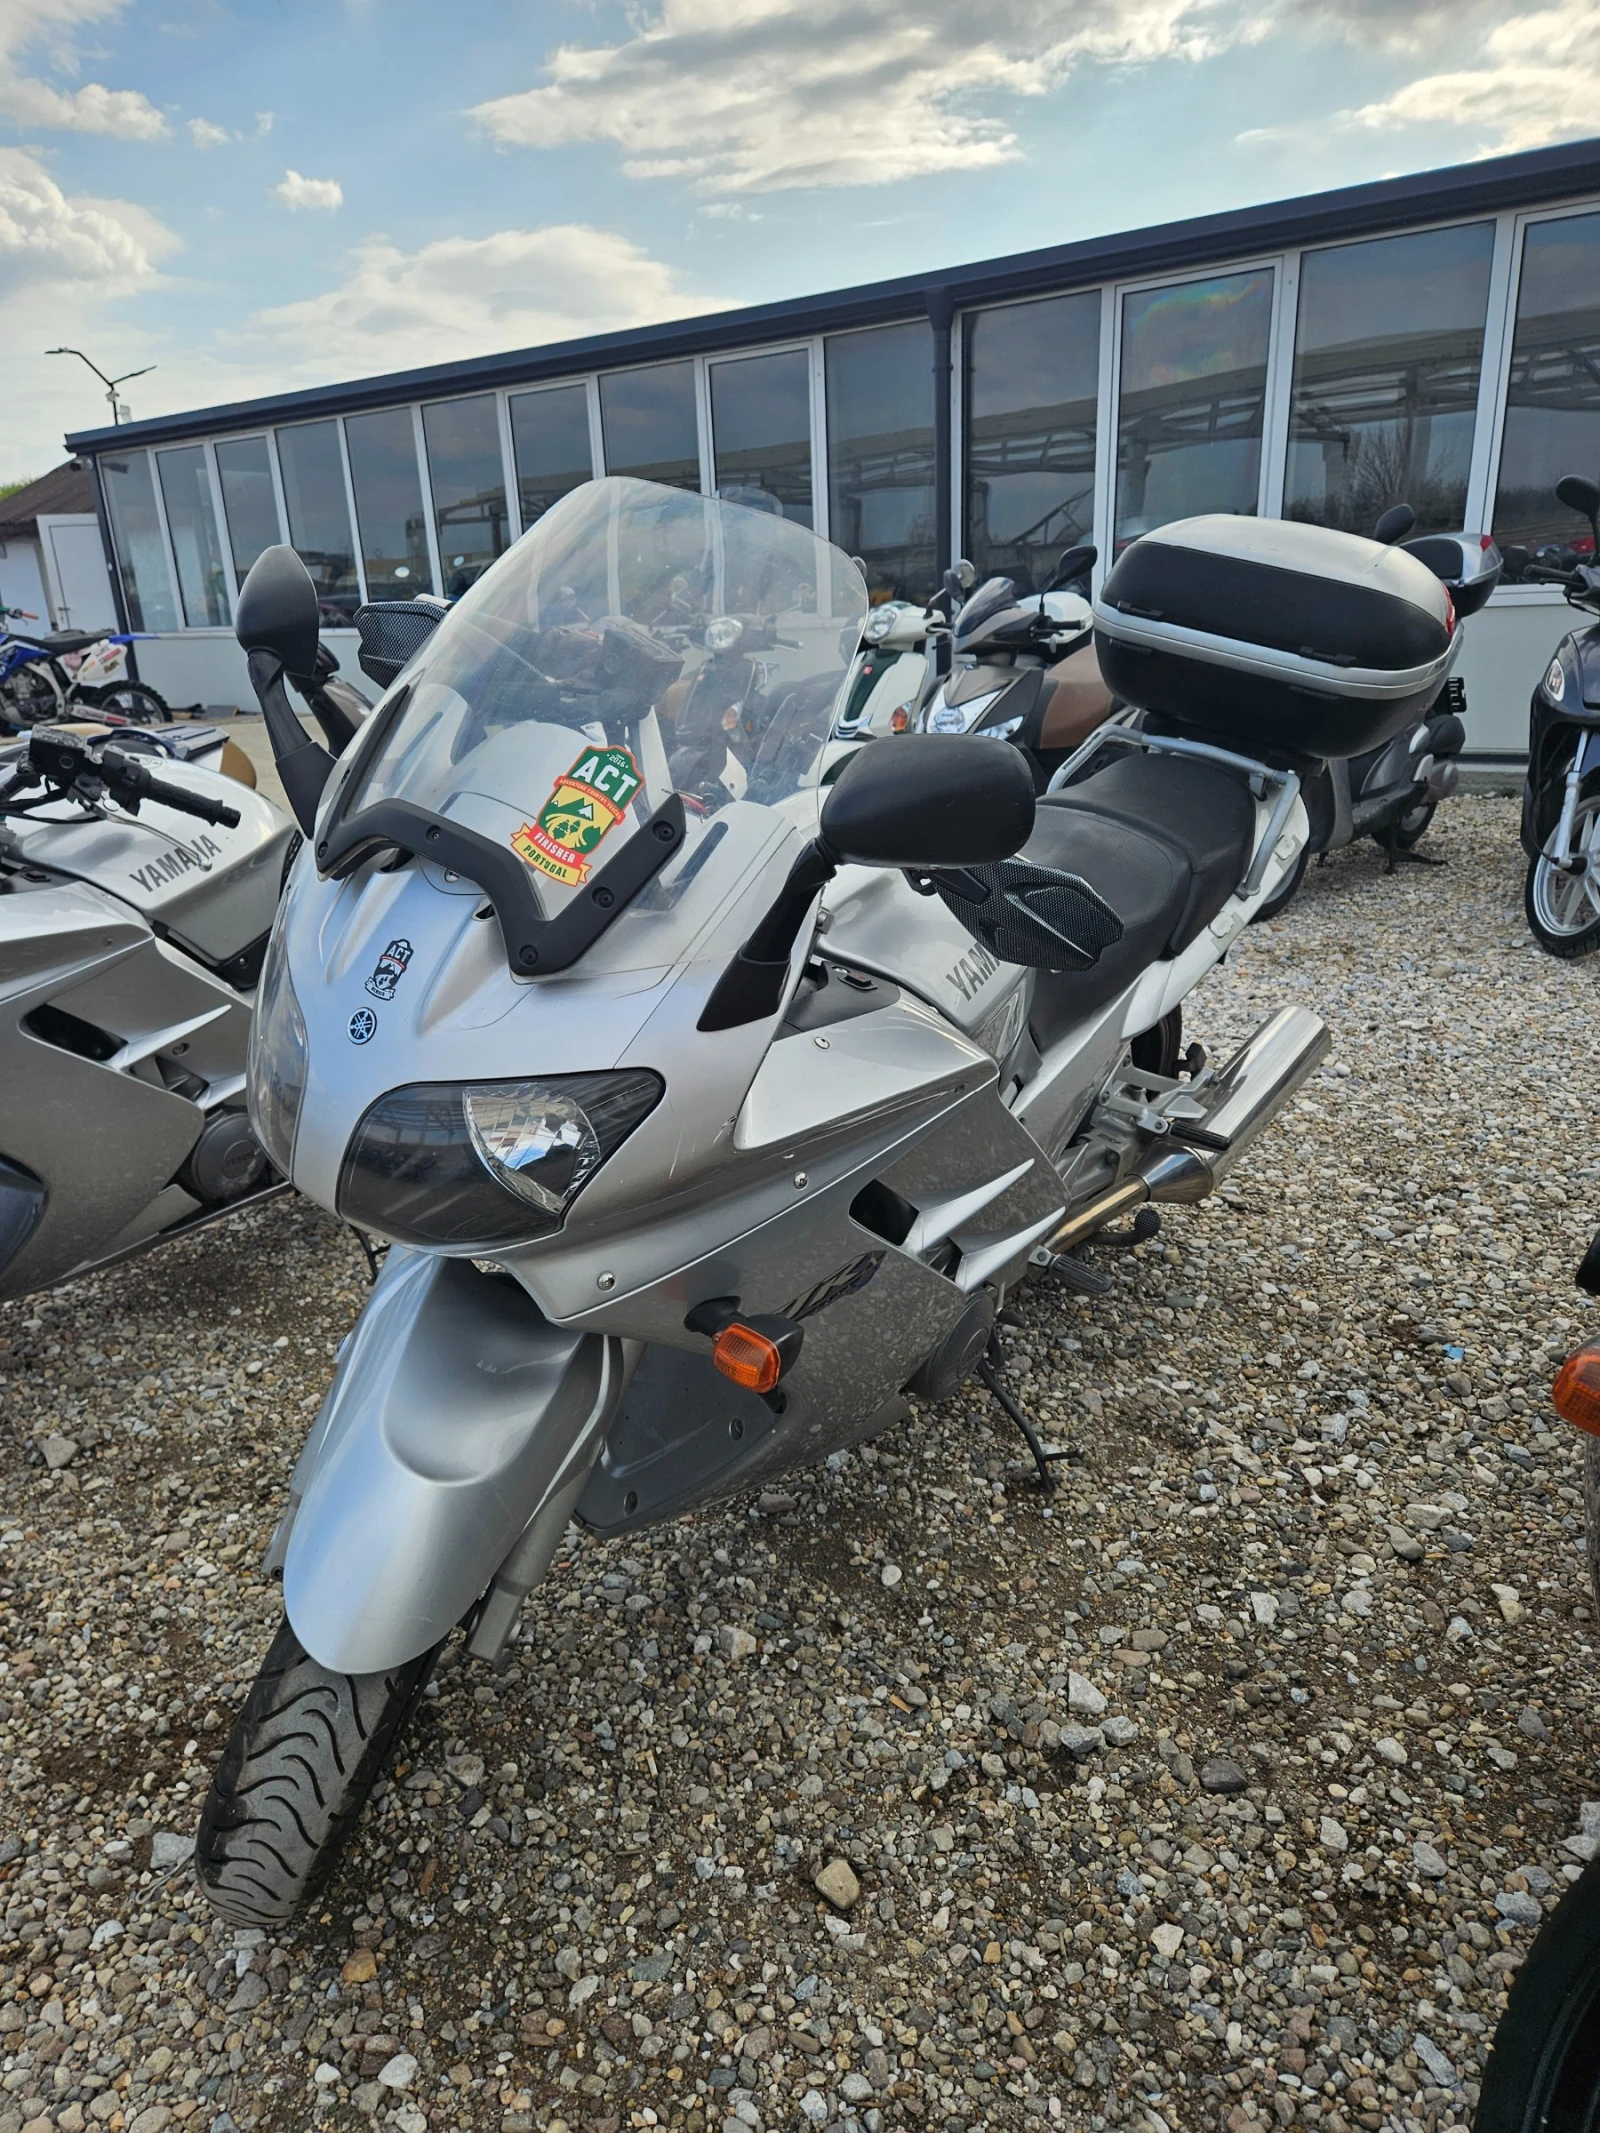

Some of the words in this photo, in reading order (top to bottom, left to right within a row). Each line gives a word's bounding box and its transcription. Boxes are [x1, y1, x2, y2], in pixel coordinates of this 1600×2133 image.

[609, 754, 627, 768] 2016
[559, 779, 587, 792] ADVENTURE
[587, 786, 607, 804] COUNTRY
[571, 755, 638, 803] ACT
[523, 844, 567, 878] PORTUGAL
[533, 832, 576, 863] FINISHER
[386, 944, 411, 963] ACT
[945, 940, 1001, 1002] YAM
